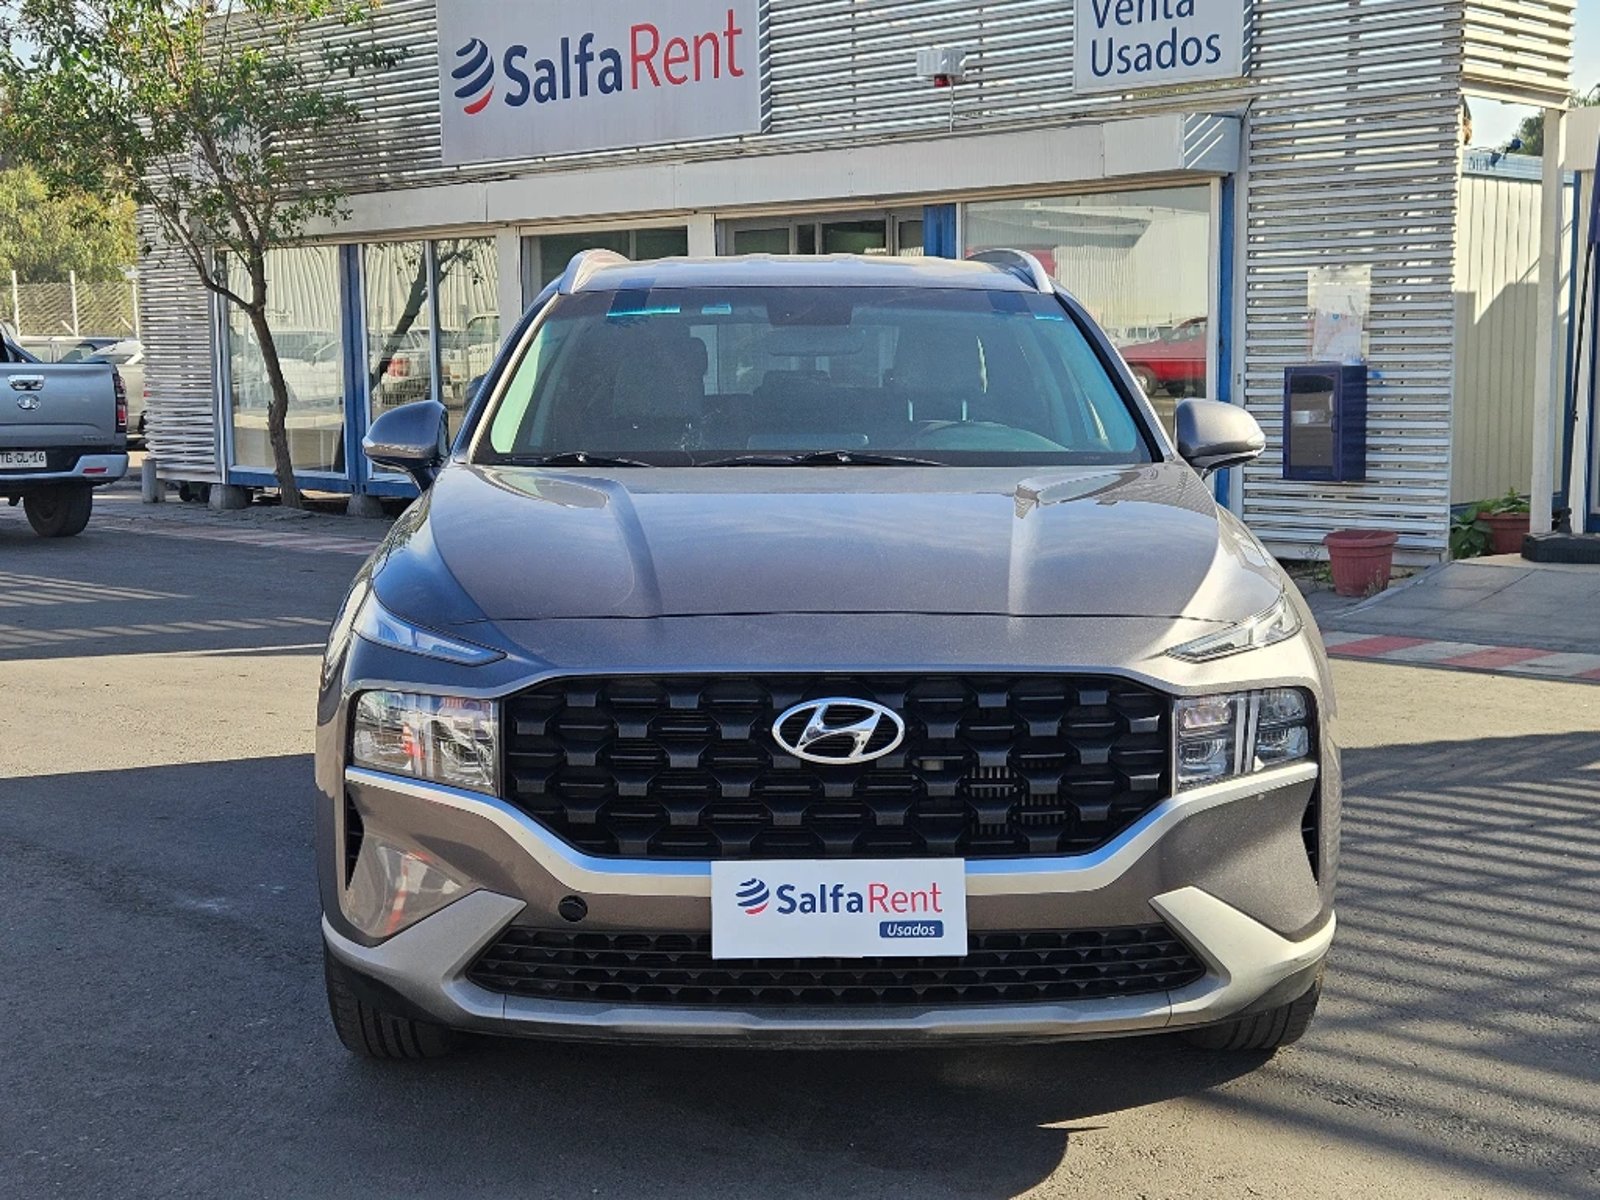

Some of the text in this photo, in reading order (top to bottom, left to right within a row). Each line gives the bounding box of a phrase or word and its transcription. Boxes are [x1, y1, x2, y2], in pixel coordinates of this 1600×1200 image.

[503, 9, 744, 107] SalfaRent
[1091, 27, 1221, 77] Usados
[776, 882, 943, 915] SalfaRent
[886, 923, 936, 937] Usados
